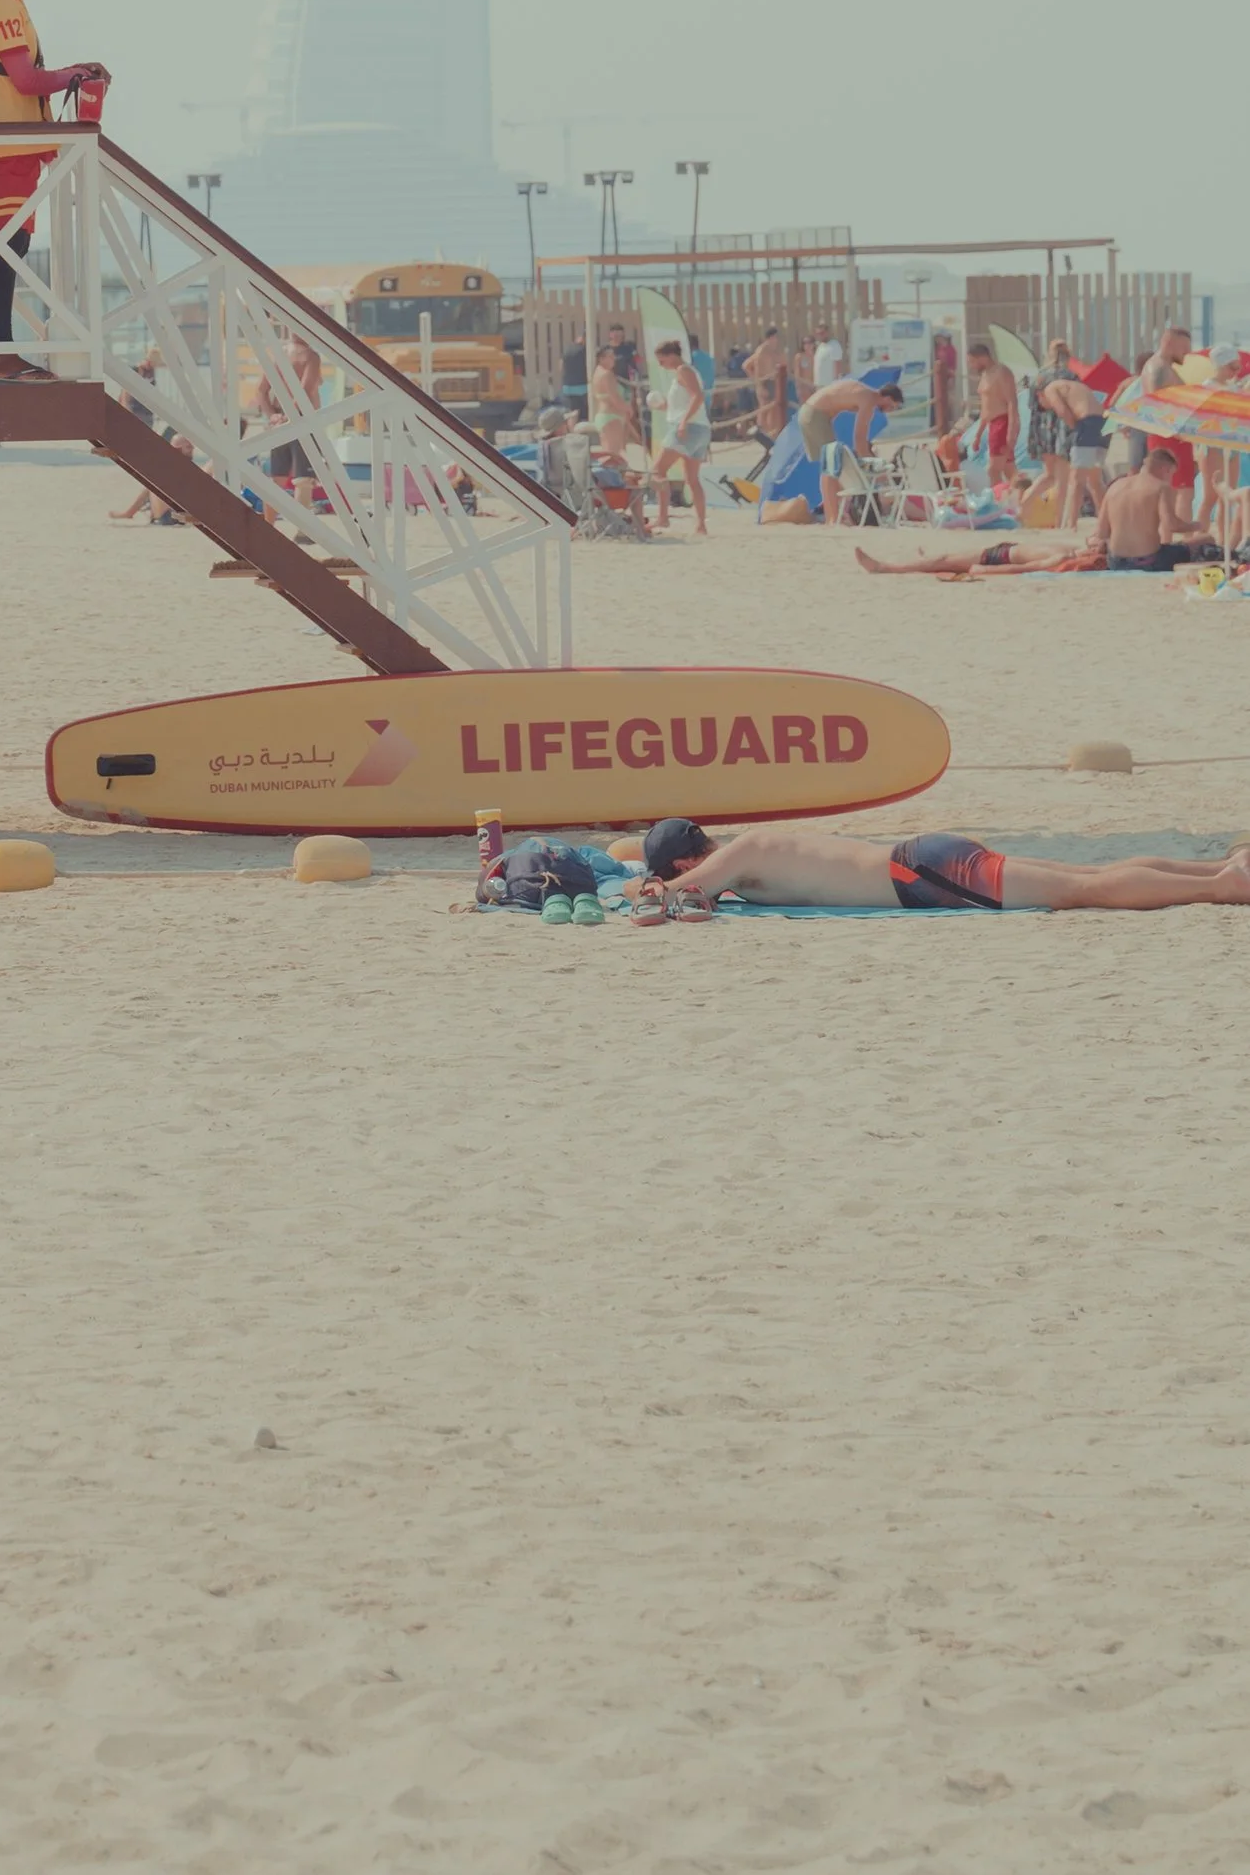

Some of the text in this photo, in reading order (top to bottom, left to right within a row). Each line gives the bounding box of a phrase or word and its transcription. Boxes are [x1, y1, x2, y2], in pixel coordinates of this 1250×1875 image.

[208, 744, 335, 776] بلدية دبي
[461, 714, 869, 774] LIFEGUARD
[209, 778, 337, 794] DUBAI MUNICIPALITY
